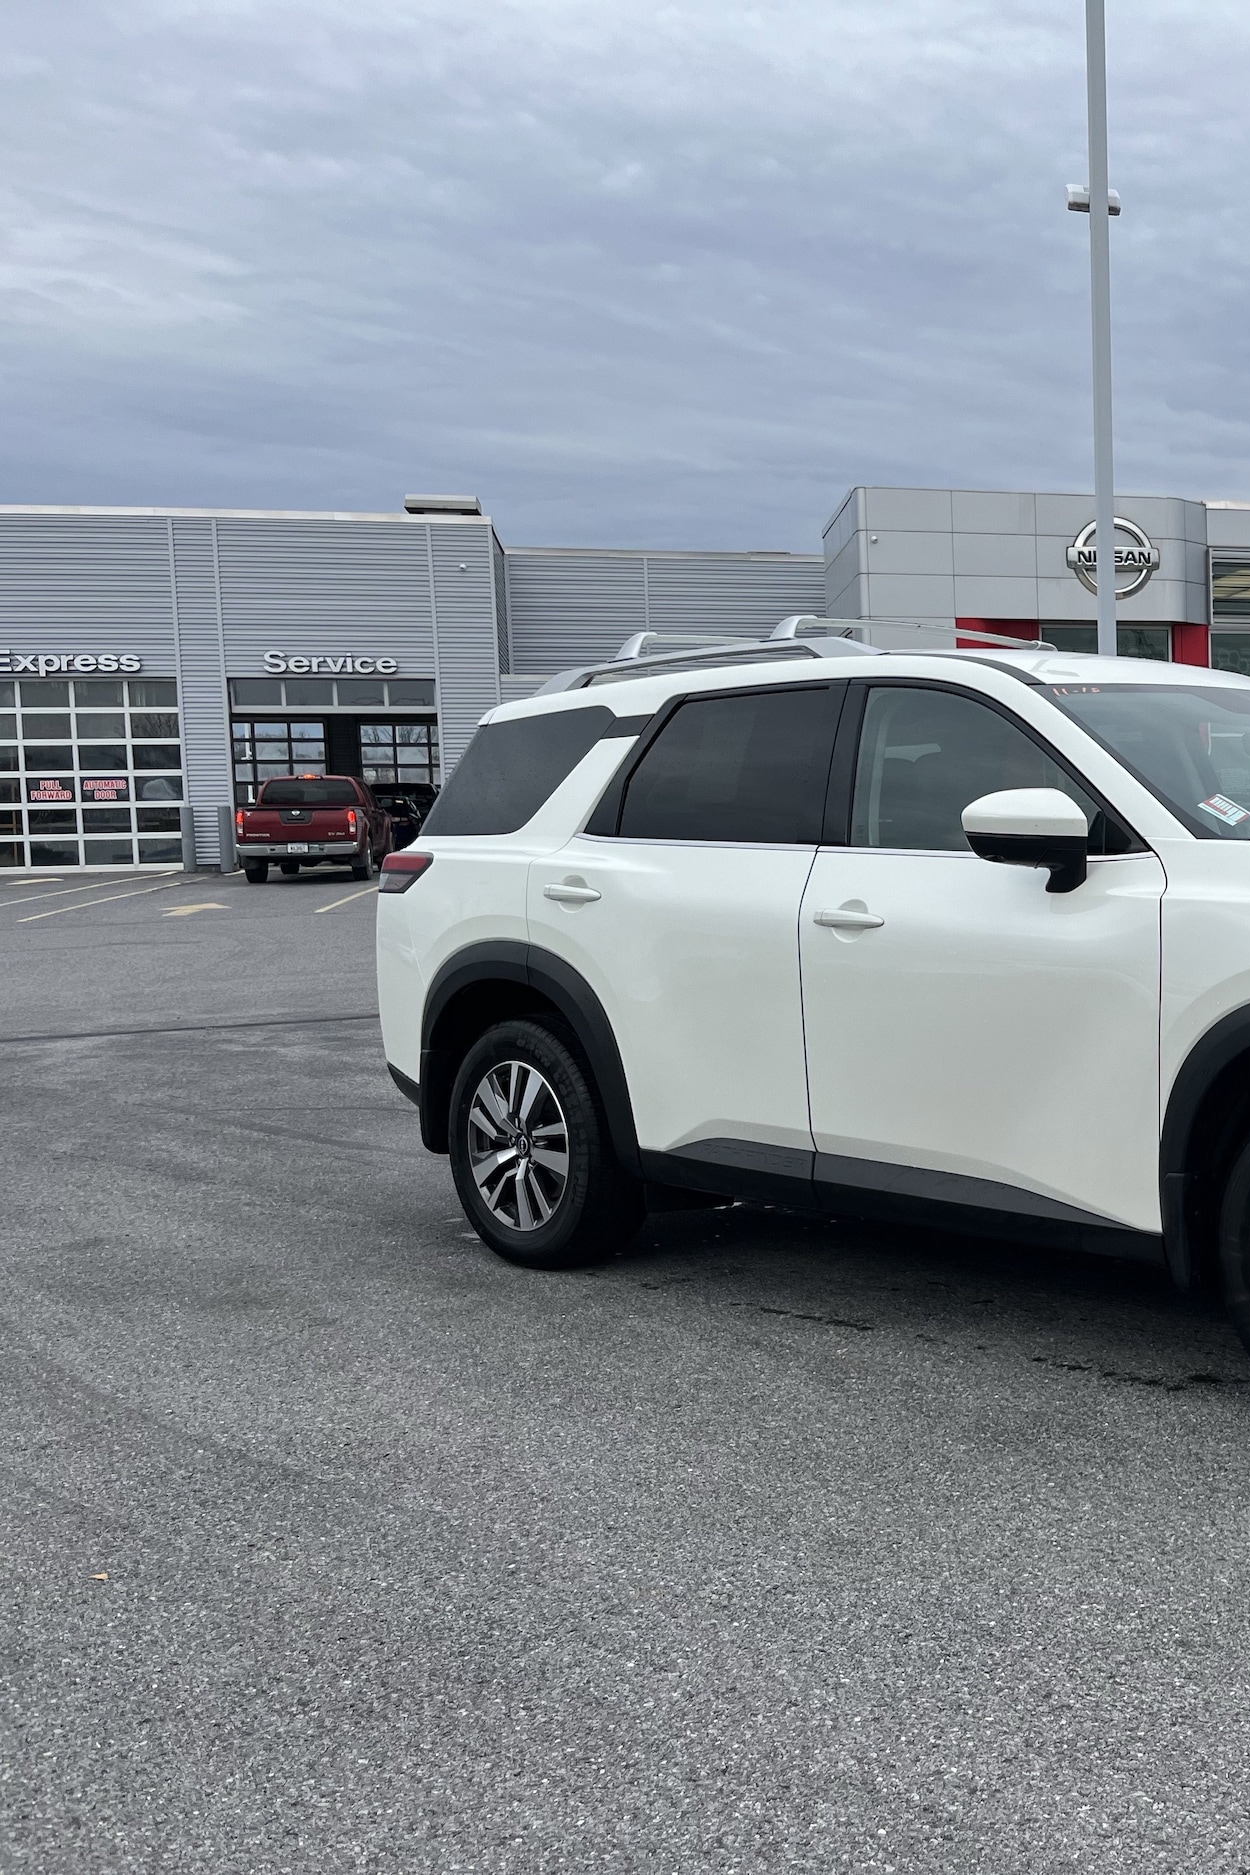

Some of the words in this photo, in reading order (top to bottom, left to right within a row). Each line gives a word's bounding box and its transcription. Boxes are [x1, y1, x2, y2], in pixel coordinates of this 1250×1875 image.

[1077, 550, 1151, 567] NISAN
[0, 649, 141, 677] Express
[263, 650, 398, 674] Service
[40, 780, 62, 790] PULL
[83, 780, 127, 790] AUTOMATIC
[30, 790, 72, 800] FORWARD
[94, 790, 117, 800] DOOR
